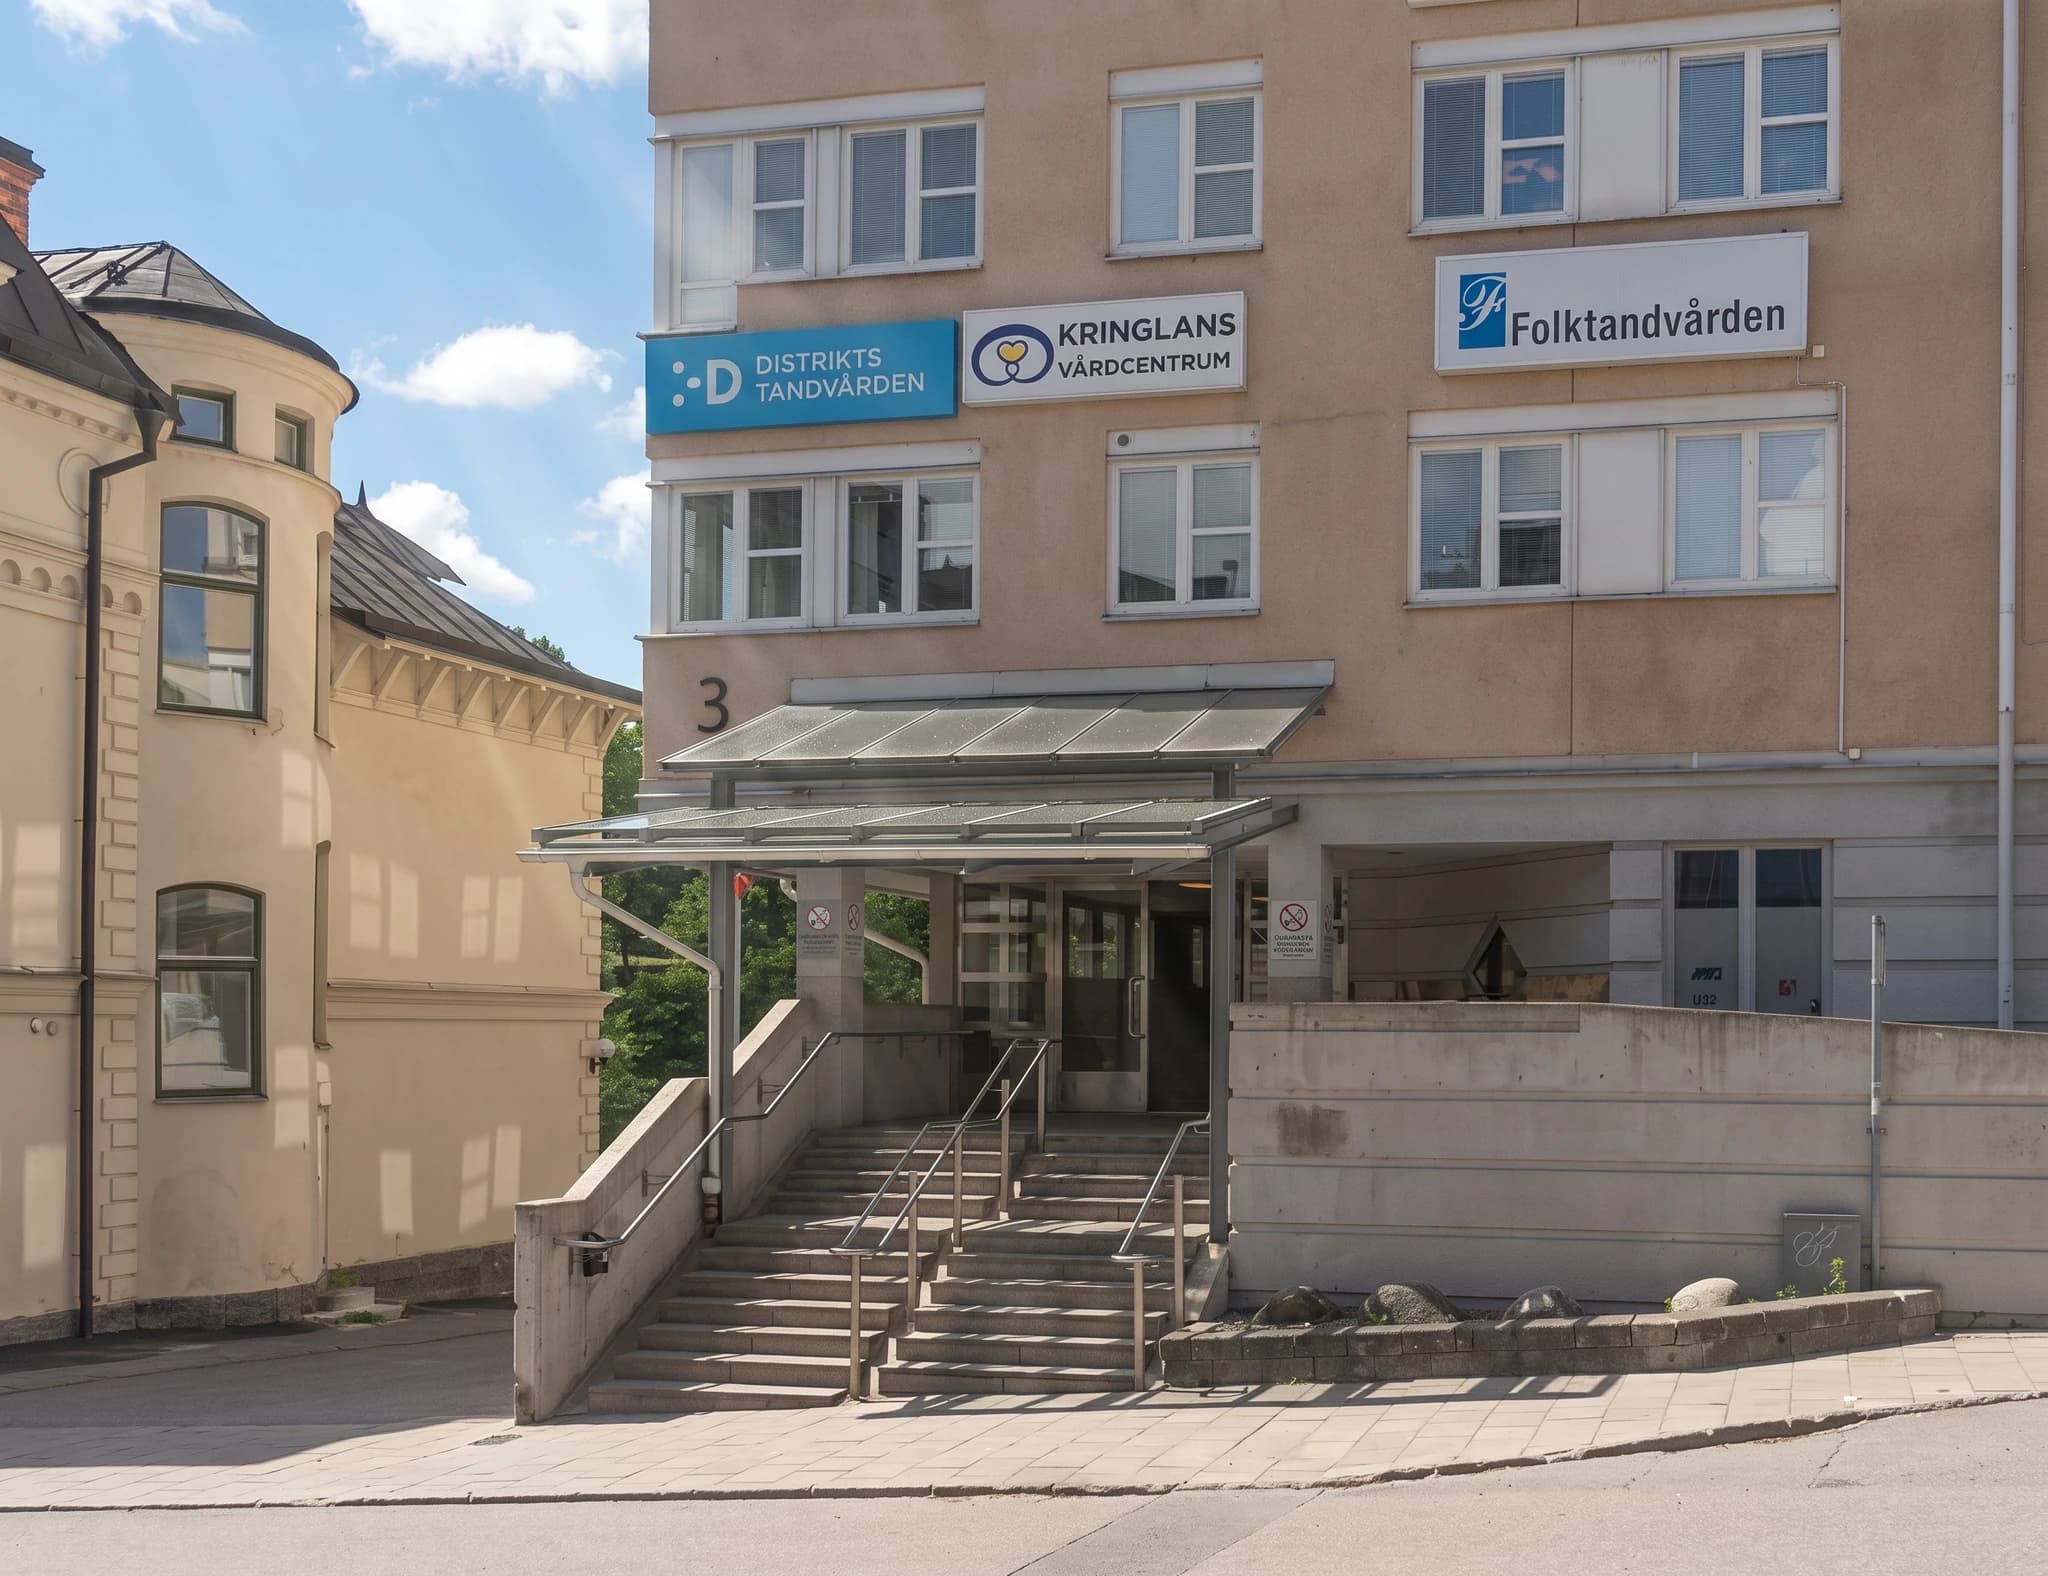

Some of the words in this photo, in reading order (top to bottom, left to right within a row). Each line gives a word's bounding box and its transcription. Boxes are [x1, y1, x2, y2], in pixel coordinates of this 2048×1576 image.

[1058, 312, 1236, 347] KRINGLANS
[1512, 298, 1785, 346] Folktandvården
[756, 348, 882, 376] DISTRIKTS
[1057, 351, 1231, 379] VÅRDCENTRUM
[755, 372, 925, 402] TANDVÅRDEN
[697, 676, 729, 734] 3
[1693, 993, 1718, 1006] U32
